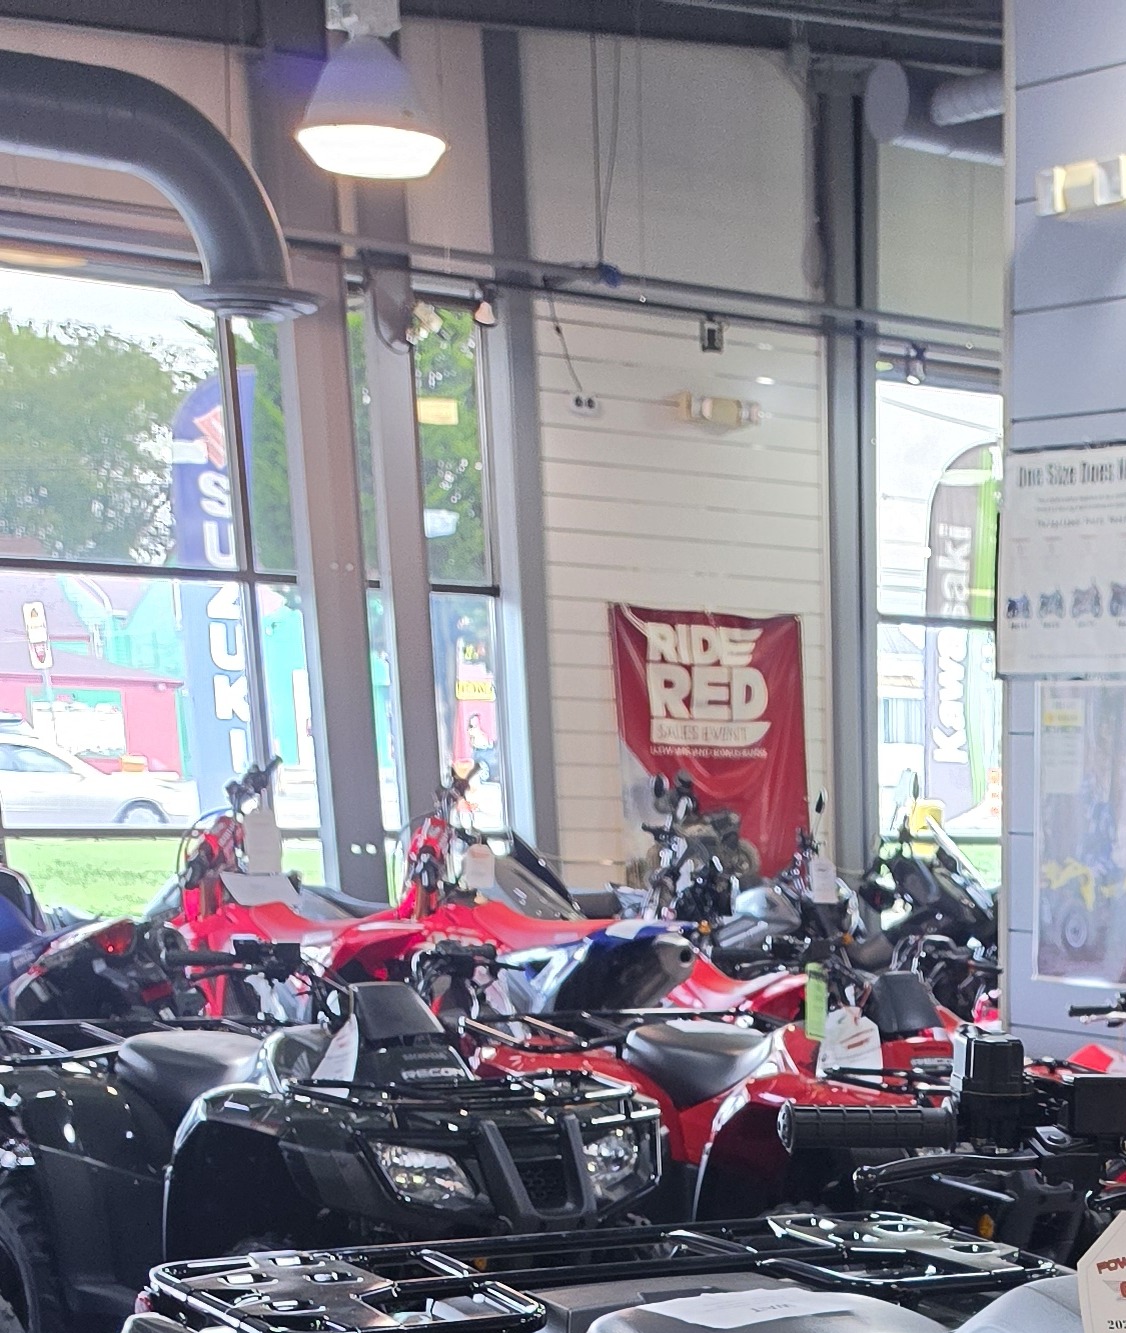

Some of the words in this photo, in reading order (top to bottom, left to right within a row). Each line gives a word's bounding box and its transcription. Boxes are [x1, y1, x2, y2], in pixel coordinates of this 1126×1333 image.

[1047, 463, 1076, 486] Size
[197, 470, 250, 774] SUZUKI
[646, 621, 764, 667] RIDE
[646, 662, 769, 722] RED
[657, 723, 699, 741] SALES
[702, 724, 749, 742] EVENT
[401, 1067, 465, 1081] RECON
